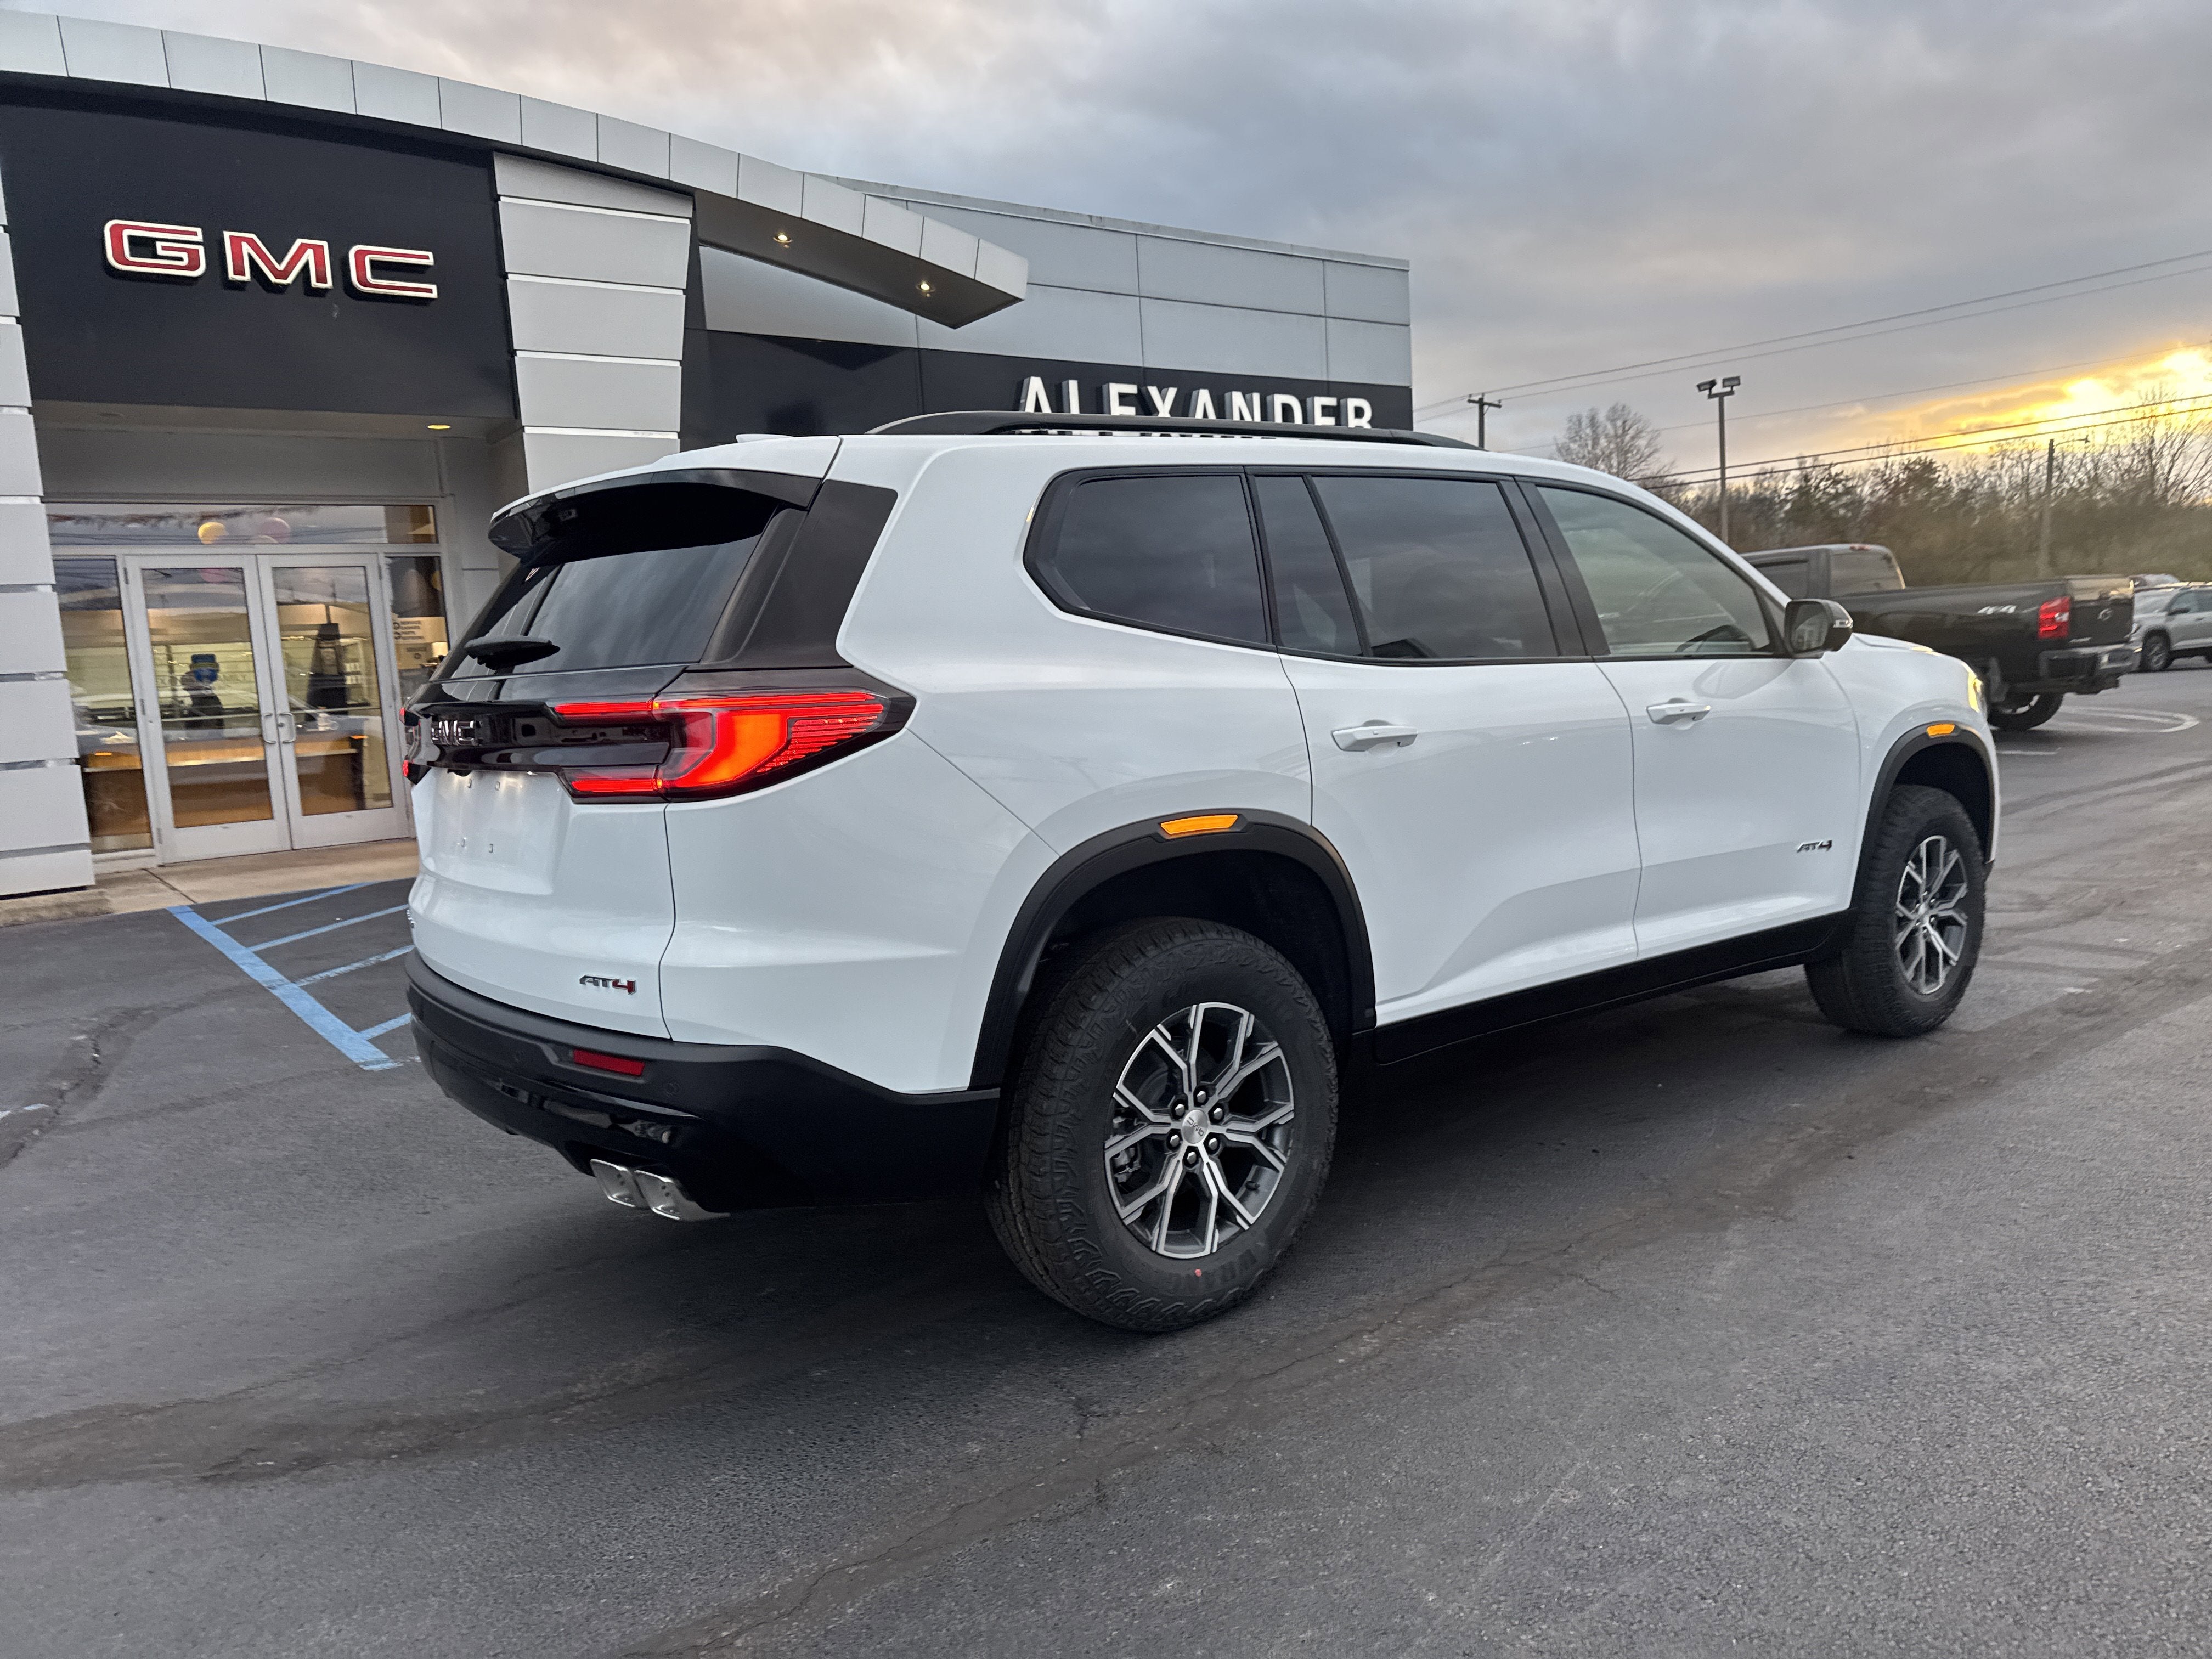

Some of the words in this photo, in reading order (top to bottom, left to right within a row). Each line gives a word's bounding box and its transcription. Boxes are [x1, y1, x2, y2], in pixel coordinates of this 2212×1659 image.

[104, 219, 438, 298] GMC
[1022, 376, 1373, 437] ALEXANDER
[431, 719, 476, 746] GMC
[1797, 840, 1832, 853] AT4
[579, 975, 636, 995] AT4
[1187, 1116, 1204, 1137] GMC
